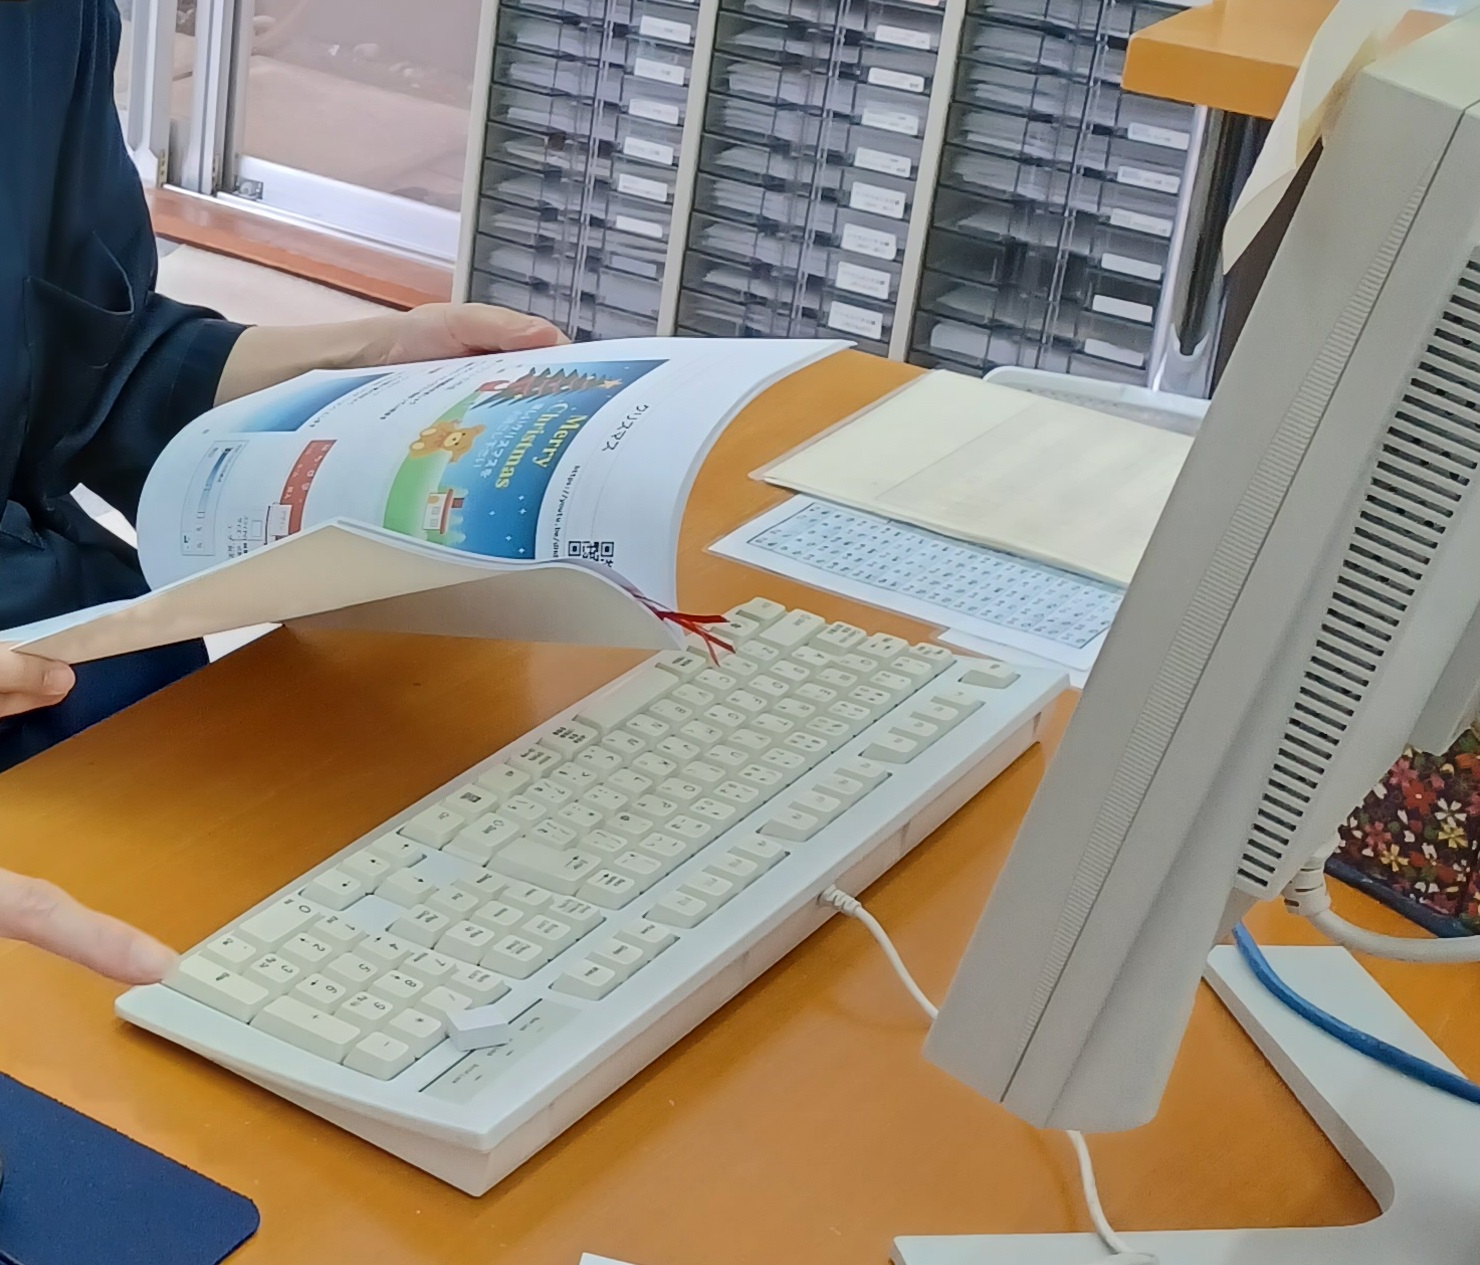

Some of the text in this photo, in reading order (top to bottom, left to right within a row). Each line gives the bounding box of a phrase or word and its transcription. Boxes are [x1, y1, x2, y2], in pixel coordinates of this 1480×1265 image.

[602, 404, 649, 452] クリスマス
[494, 401, 570, 490] Christmas
[532, 414, 589, 468] Merry
[297, 904, 312, 914] 0
[311, 942, 326, 952] 2
[357, 962, 371, 973] 5
[434, 958, 446, 967] 7
[280, 964, 293, 974] 3
[403, 978, 417, 988] 8
[324, 984, 338, 994] 6
[372, 1000, 386, 1010] 9
